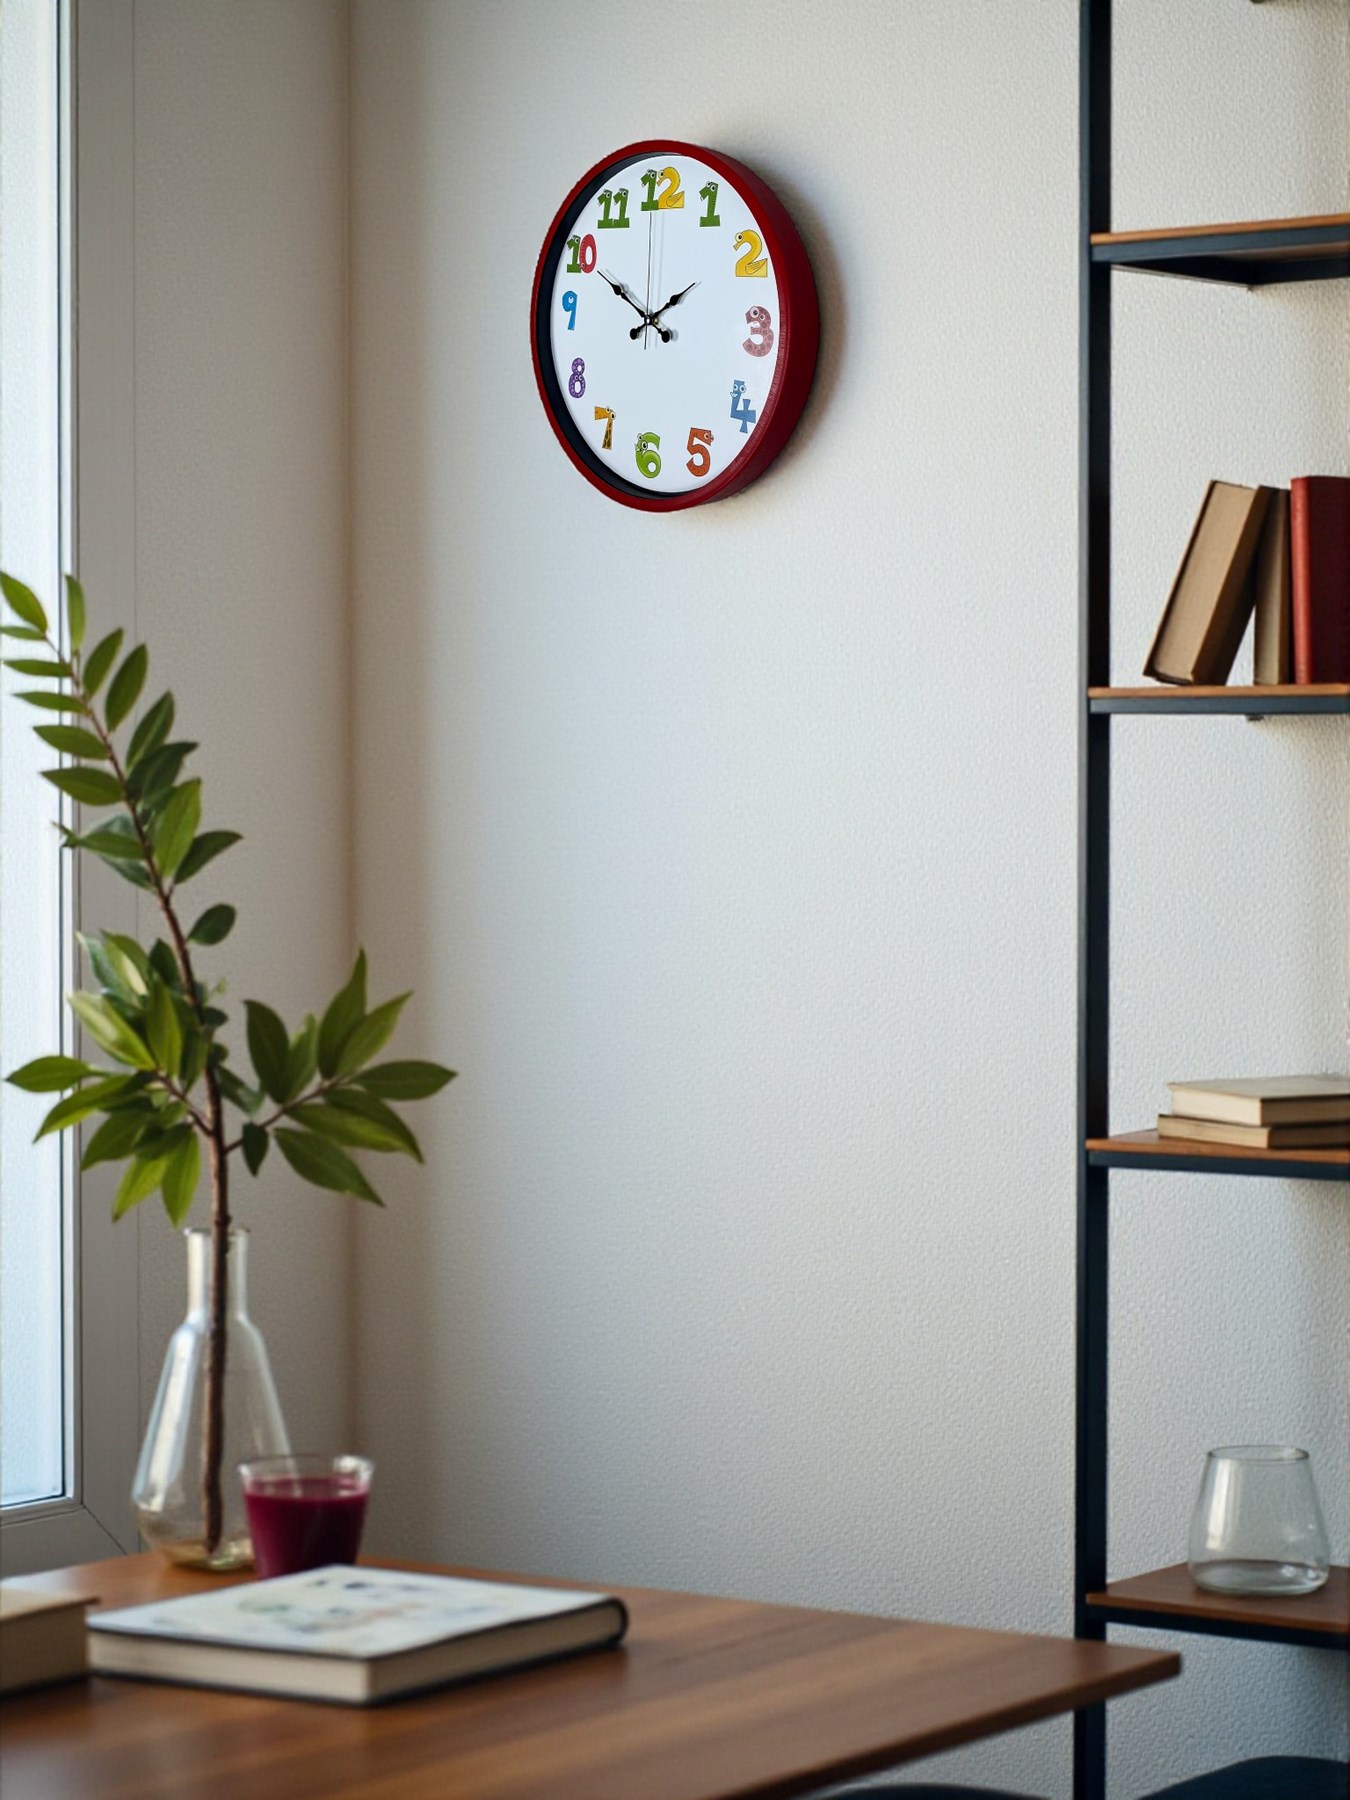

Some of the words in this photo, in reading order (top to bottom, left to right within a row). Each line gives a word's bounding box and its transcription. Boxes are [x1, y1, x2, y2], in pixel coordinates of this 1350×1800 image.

[597, 187, 630, 229] 11
[641, 166, 685, 212] 12
[699, 181, 721, 227] 1
[566, 233, 597, 274] 10
[733, 229, 768, 277] 2
[562, 290, 578, 331] 9
[742, 306, 774, 357] 3
[568, 357, 586, 399] 8
[594, 406, 616, 450] 7
[730, 379, 756, 434] 4
[634, 432, 661, 478] 6
[686, 427, 714, 477] 5
